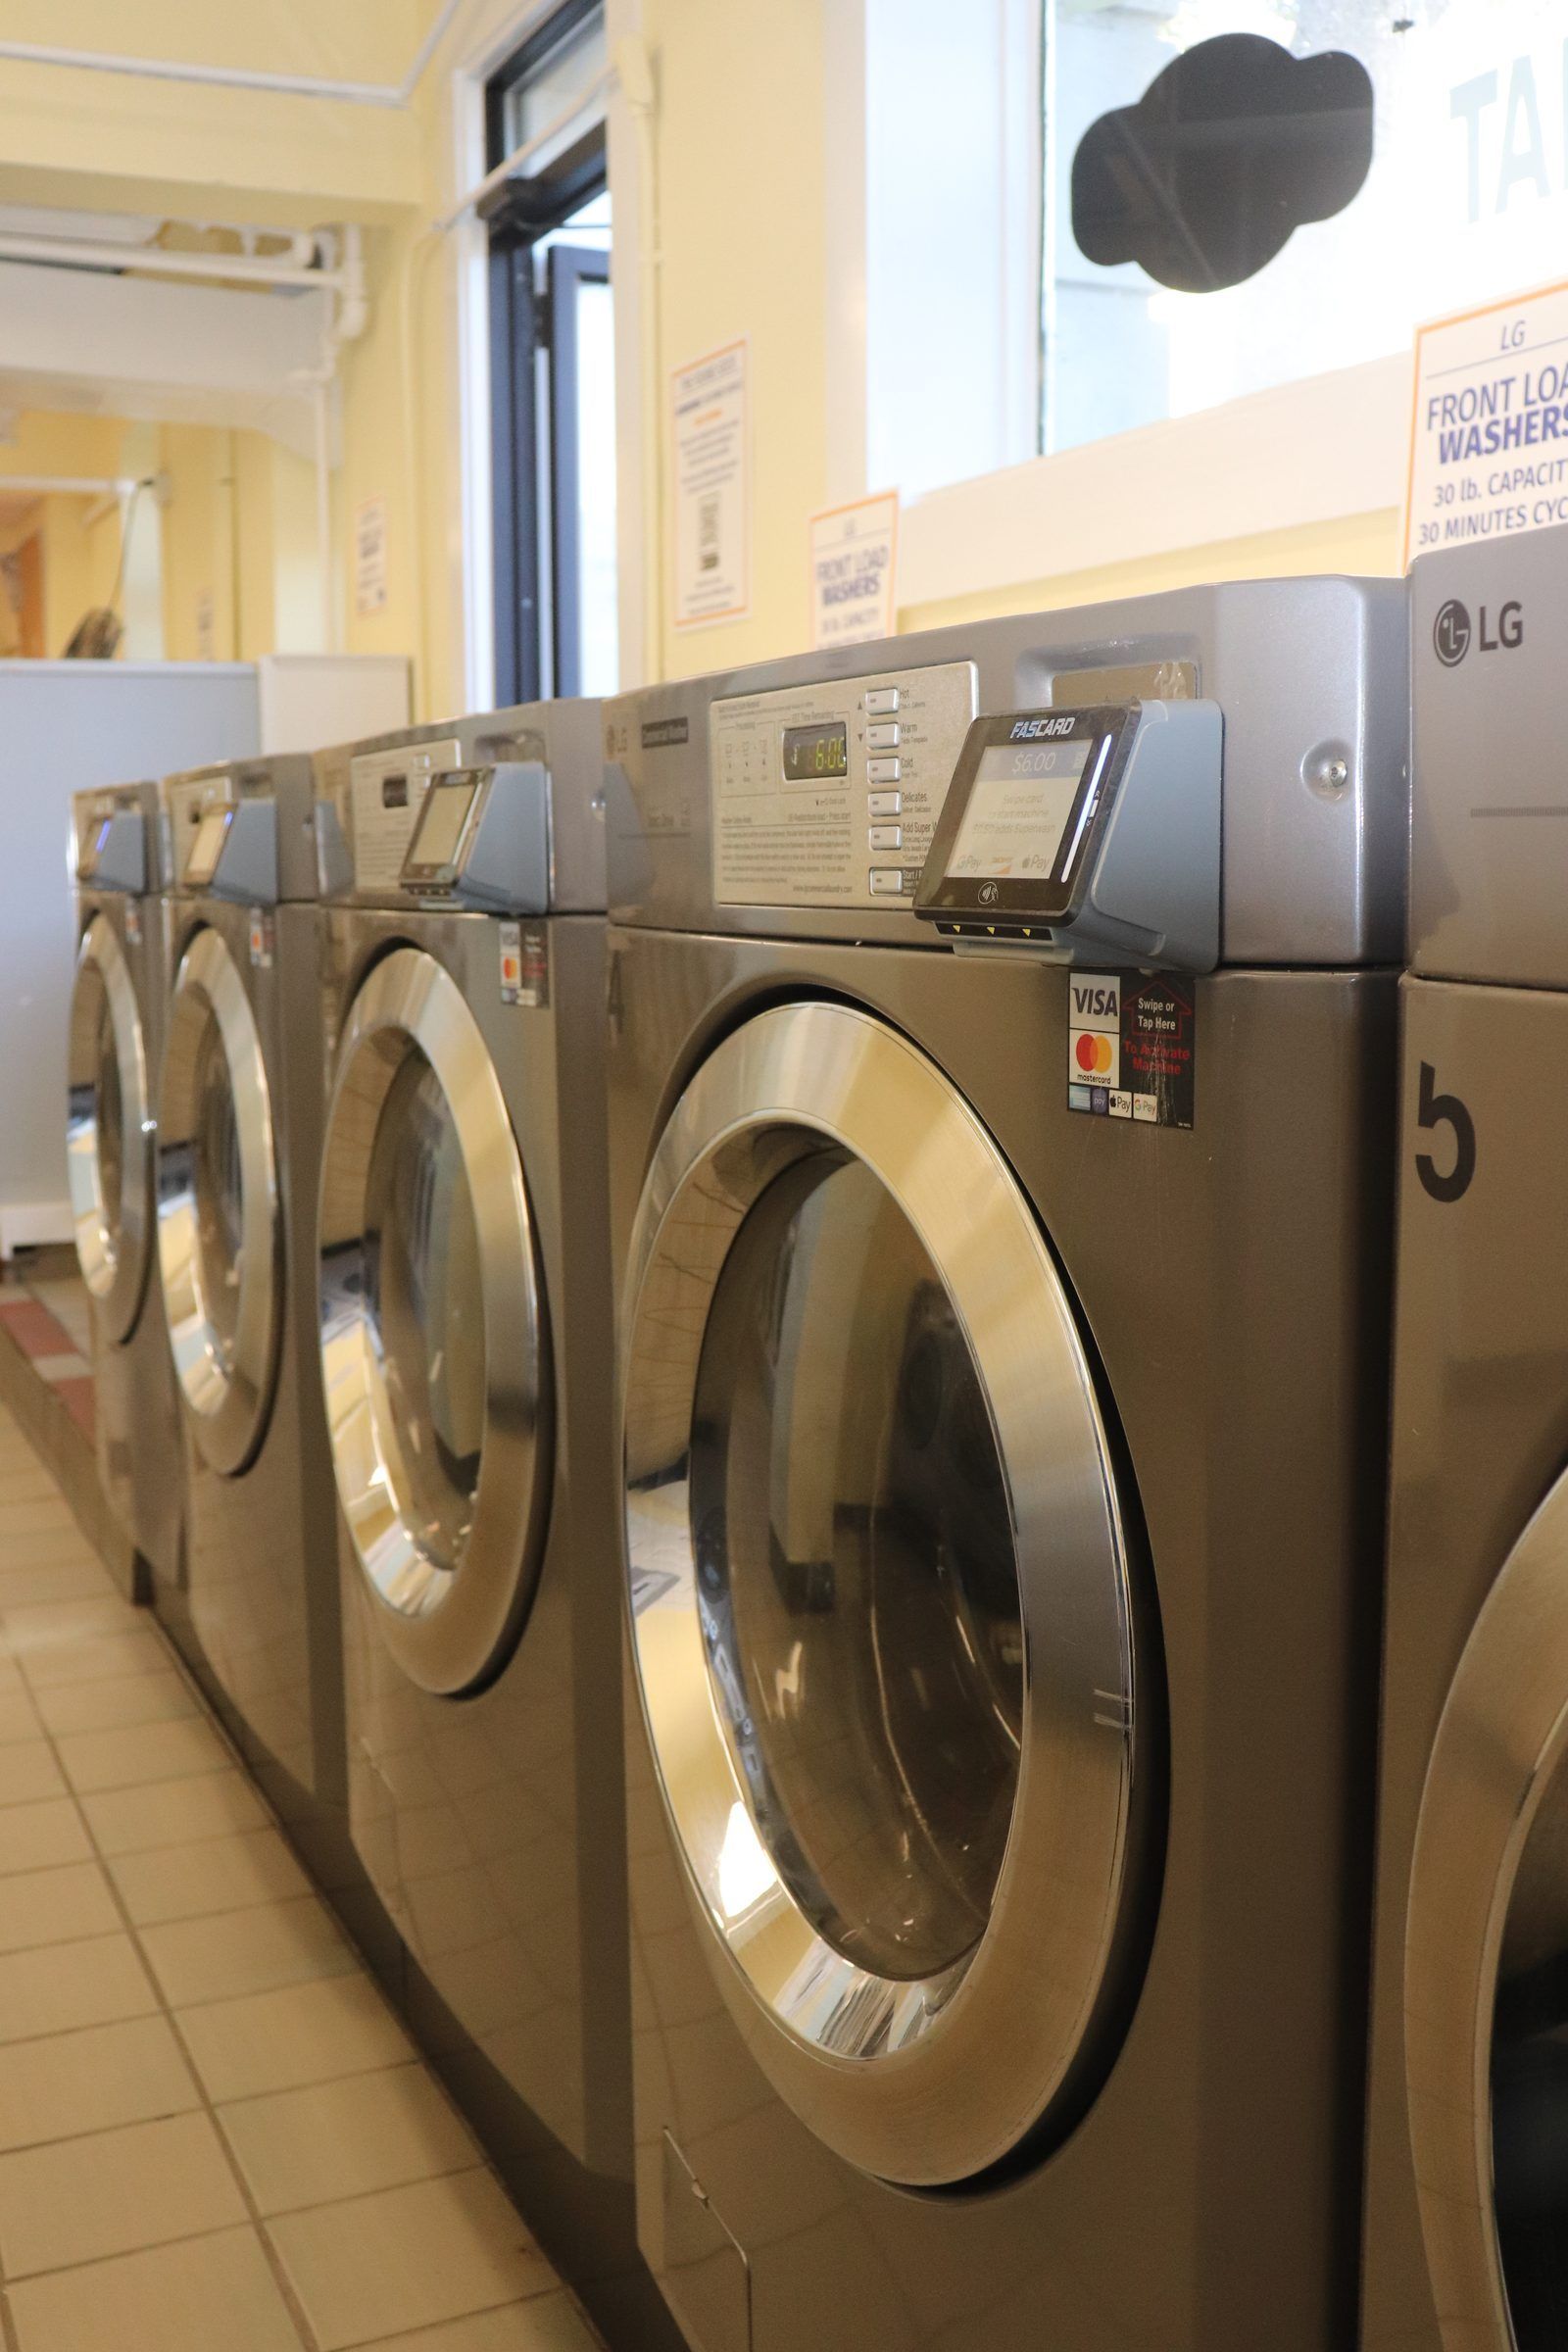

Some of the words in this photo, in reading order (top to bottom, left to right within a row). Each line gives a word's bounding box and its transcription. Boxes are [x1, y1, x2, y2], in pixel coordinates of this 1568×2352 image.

[1500, 320, 1526, 350] LG
[1427, 376, 1516, 431] FRONT
[1435, 483, 1455, 507] 30
[1461, 476, 1482, 502] lb.
[1419, 521, 1439, 545] 30
[1446, 504, 1528, 540] MINUTES
[1479, 601, 1523, 652] LG
[1009, 717, 1075, 739] FASCARD
[1011, 751, 1056, 774] $6.00
[1071, 987, 1118, 1017] VISA
[1138, 998, 1163, 1011] Swipe
[1165, 1003, 1175, 1011] or
[1138, 1015, 1153, 1030] Tap
[1155, 1017, 1176, 1030] Here
[1124, 1041, 1137, 1054] To
[1133, 1057, 1181, 1075] Machine
[1077, 1074, 1111, 1085] mastercard
[1116, 1096, 1131, 1113] Pay
[1143, 1100, 1156, 1115] Pay
[1415, 1060, 1476, 1202] 5
